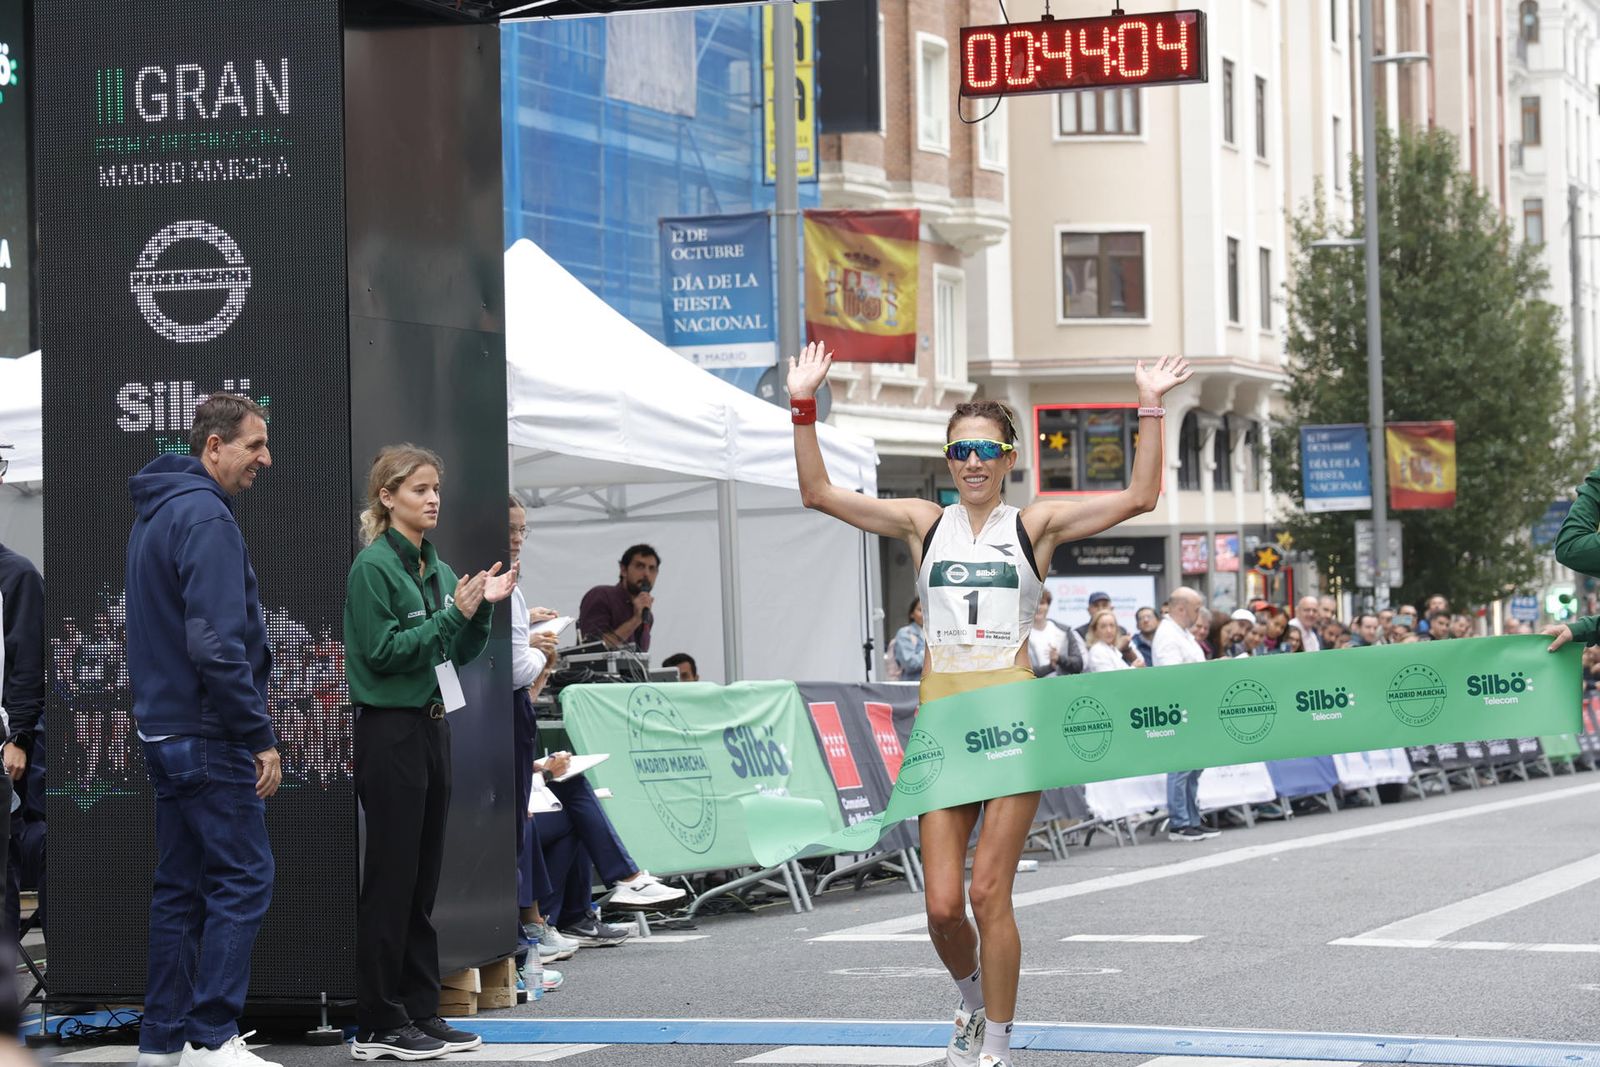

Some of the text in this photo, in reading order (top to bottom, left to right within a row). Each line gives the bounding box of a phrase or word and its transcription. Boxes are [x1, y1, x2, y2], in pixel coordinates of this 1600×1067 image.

[967, 20, 1188, 88] 00:44:04
[135, 58, 290, 122] GRAN
[99, 162, 185, 187] MADRID
[671, 228, 708, 244] 12 DE
[671, 244, 744, 260] OCTUBRE
[672, 272, 759, 292] DÍA DE LA
[673, 296, 732, 312] FIESTA
[674, 314, 768, 333] NACIONAL
[963, 590, 979, 625] 1
[1389, 687, 1445, 699] MADRID MARCHA
[1466, 671, 1526, 698] Silbö
[1295, 686, 1349, 713] Silbö
[1483, 696, 1519, 705] Telecom
[1129, 703, 1182, 730] Silbö
[1220, 703, 1275, 717] MADRID MARCHA
[1312, 711, 1342, 721] Telecom
[1064, 720, 1113, 734] MADRID MARCHA
[1145, 728, 1176, 739] Telecom
[965, 721, 1028, 753] Silbö
[722, 725, 790, 778] Silbö
[912, 750, 943, 764] MARCHA
[984, 746, 1023, 761] Telecom
[635, 755, 707, 774] MADRID MARCHA
